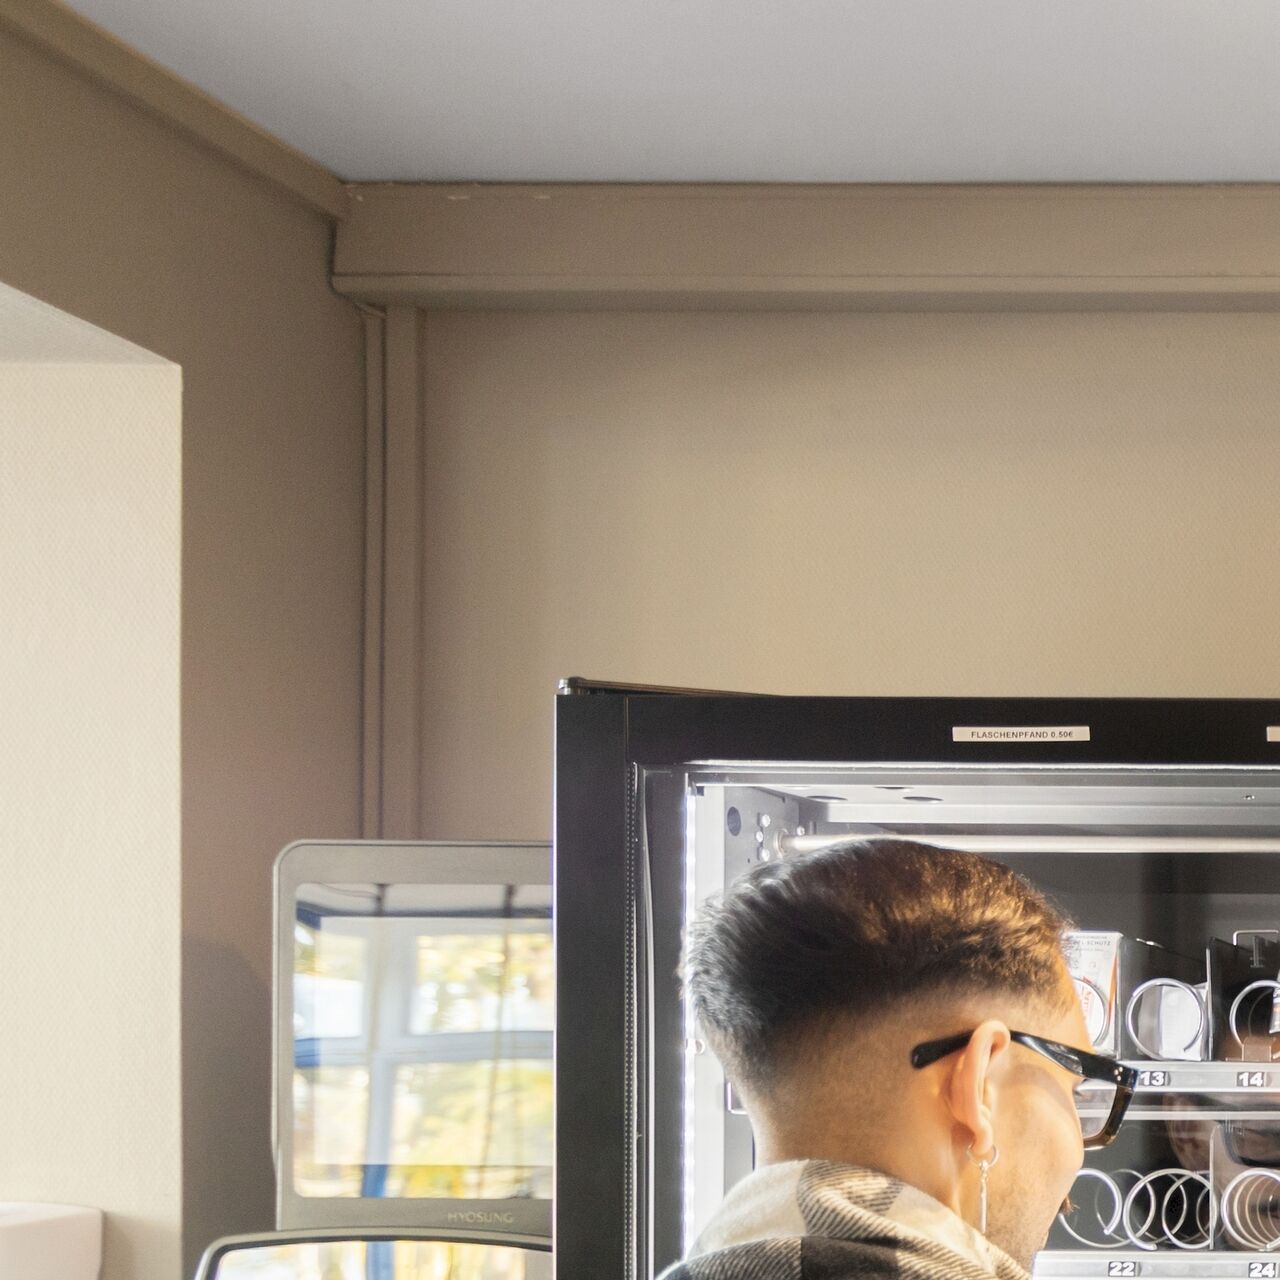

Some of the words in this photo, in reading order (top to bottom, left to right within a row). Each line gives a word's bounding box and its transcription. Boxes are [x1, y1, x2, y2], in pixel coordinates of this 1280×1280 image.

[1140, 1073, 1164, 1086] 13
[1240, 1074, 1264, 1086] 14
[1110, 1262, 1134, 1276] 22
[1250, 1264, 1275, 1277] 24
